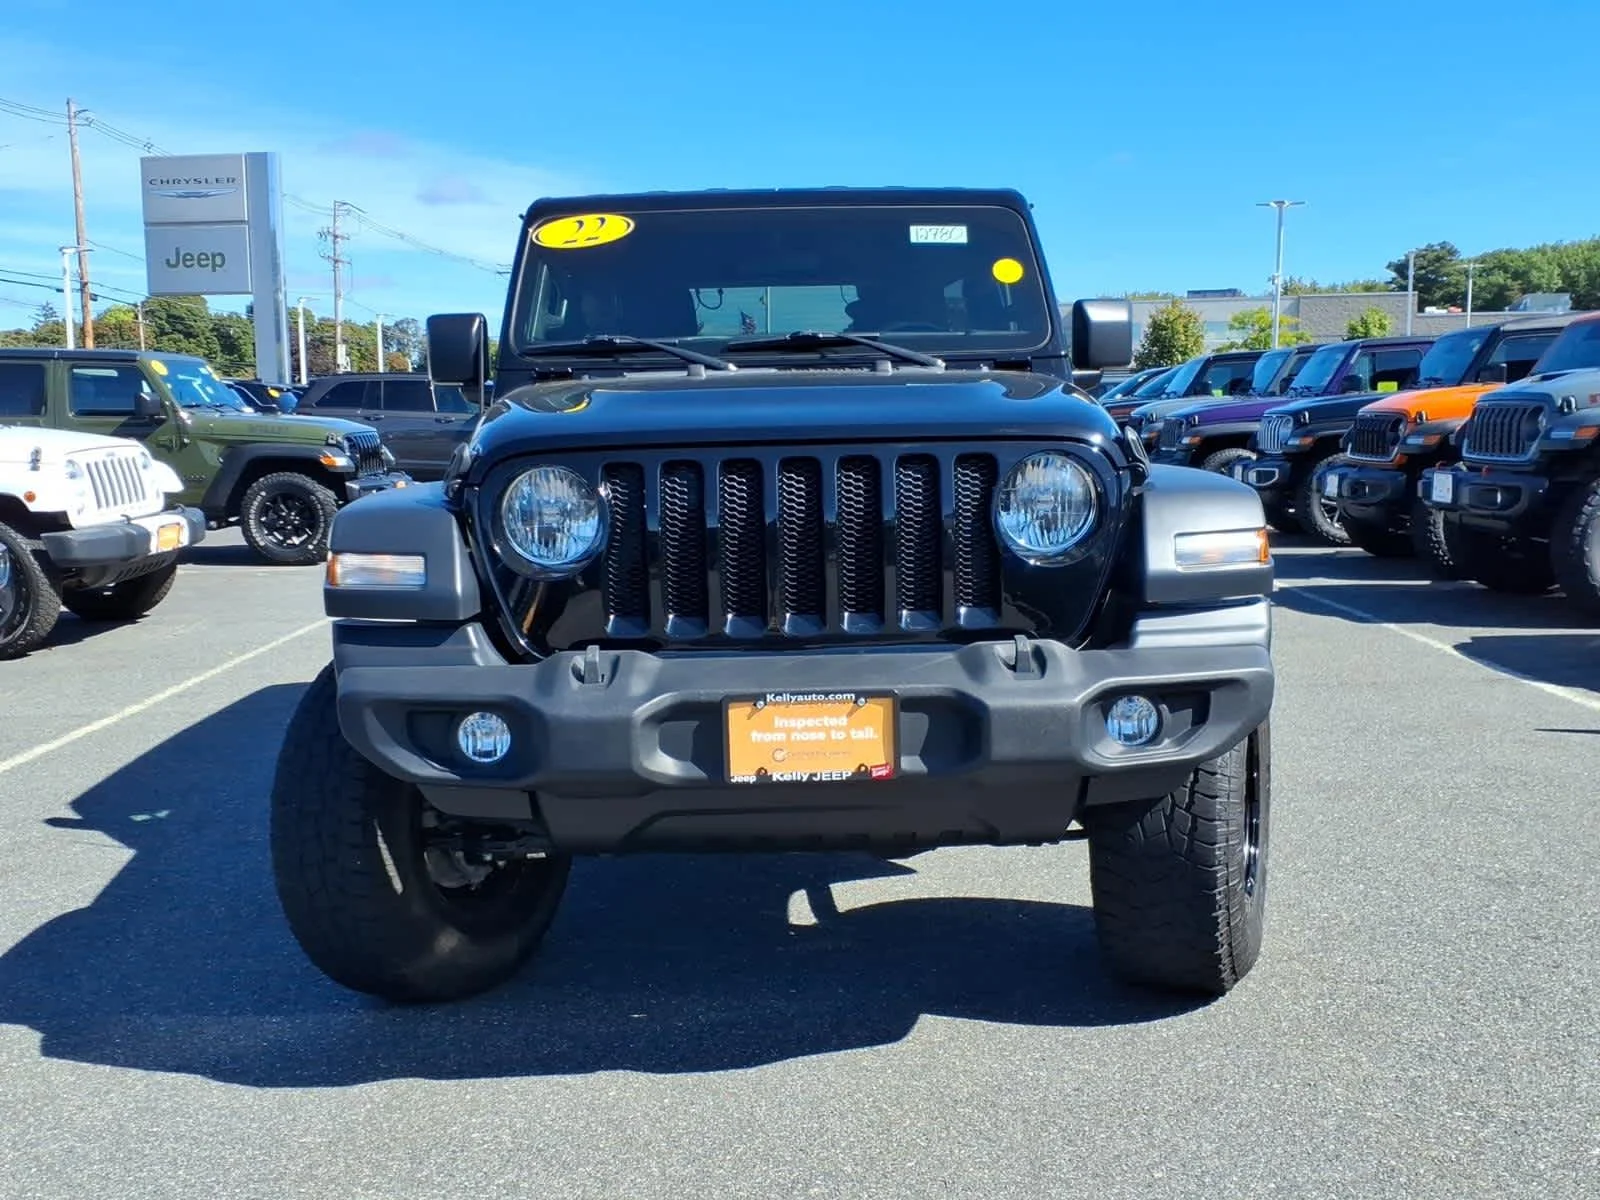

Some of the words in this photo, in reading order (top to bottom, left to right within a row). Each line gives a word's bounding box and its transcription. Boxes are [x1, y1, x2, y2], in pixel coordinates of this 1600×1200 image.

[149, 177, 237, 186] CHRYSLER
[561, 216, 607, 245] 22
[165, 247, 226, 272] Jeep
[766, 693, 855, 704] Kellyauto.com
[774, 716, 848, 729] Inspected
[751, 730, 786, 742] from
[791, 731, 826, 742] nose
[830, 729, 847, 740] to
[850, 727, 879, 740] tail.
[730, 774, 757, 785] Jeep
[772, 772, 809, 783] Kelly
[812, 771, 852, 781] JEEP
